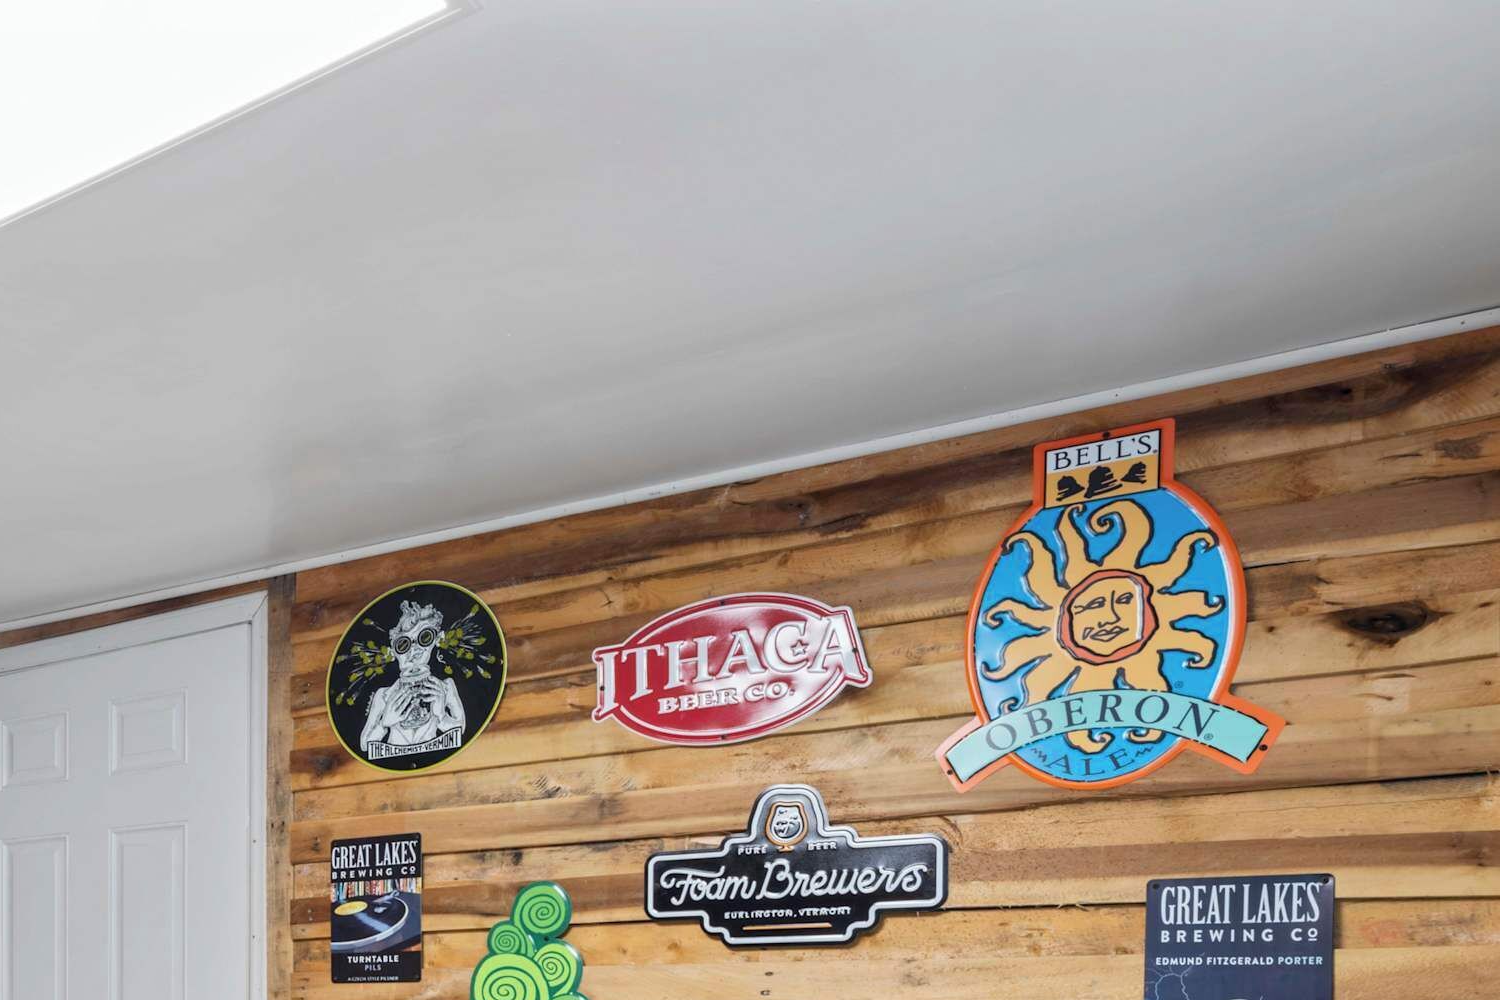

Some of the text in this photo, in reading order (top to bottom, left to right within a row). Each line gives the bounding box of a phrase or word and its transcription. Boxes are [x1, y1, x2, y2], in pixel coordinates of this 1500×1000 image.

[1052, 433, 1158, 471] BELL'S
[600, 614, 866, 712] ITHACA
[658, 682, 796, 715] BEER CO.
[984, 694, 1222, 752] OBERON
[370, 729, 460, 759] THE ALCHEMIST VERMONT
[1045, 747, 1136, 777] ALE
[331, 840, 417, 870] GREAT LAKES
[738, 842, 837, 855] PURE BEER
[332, 867, 393, 880] BREWING
[660, 858, 928, 905] Foam Brewers
[799, 906, 851, 916] VERMONT
[1160, 881, 1322, 925] GREAT LAKES
[1160, 928, 1274, 943] BREWING
[347, 955, 399, 964] TURNTABLE
[1155, 956, 1323, 966] EDMUND FITZGERALD PORTER
